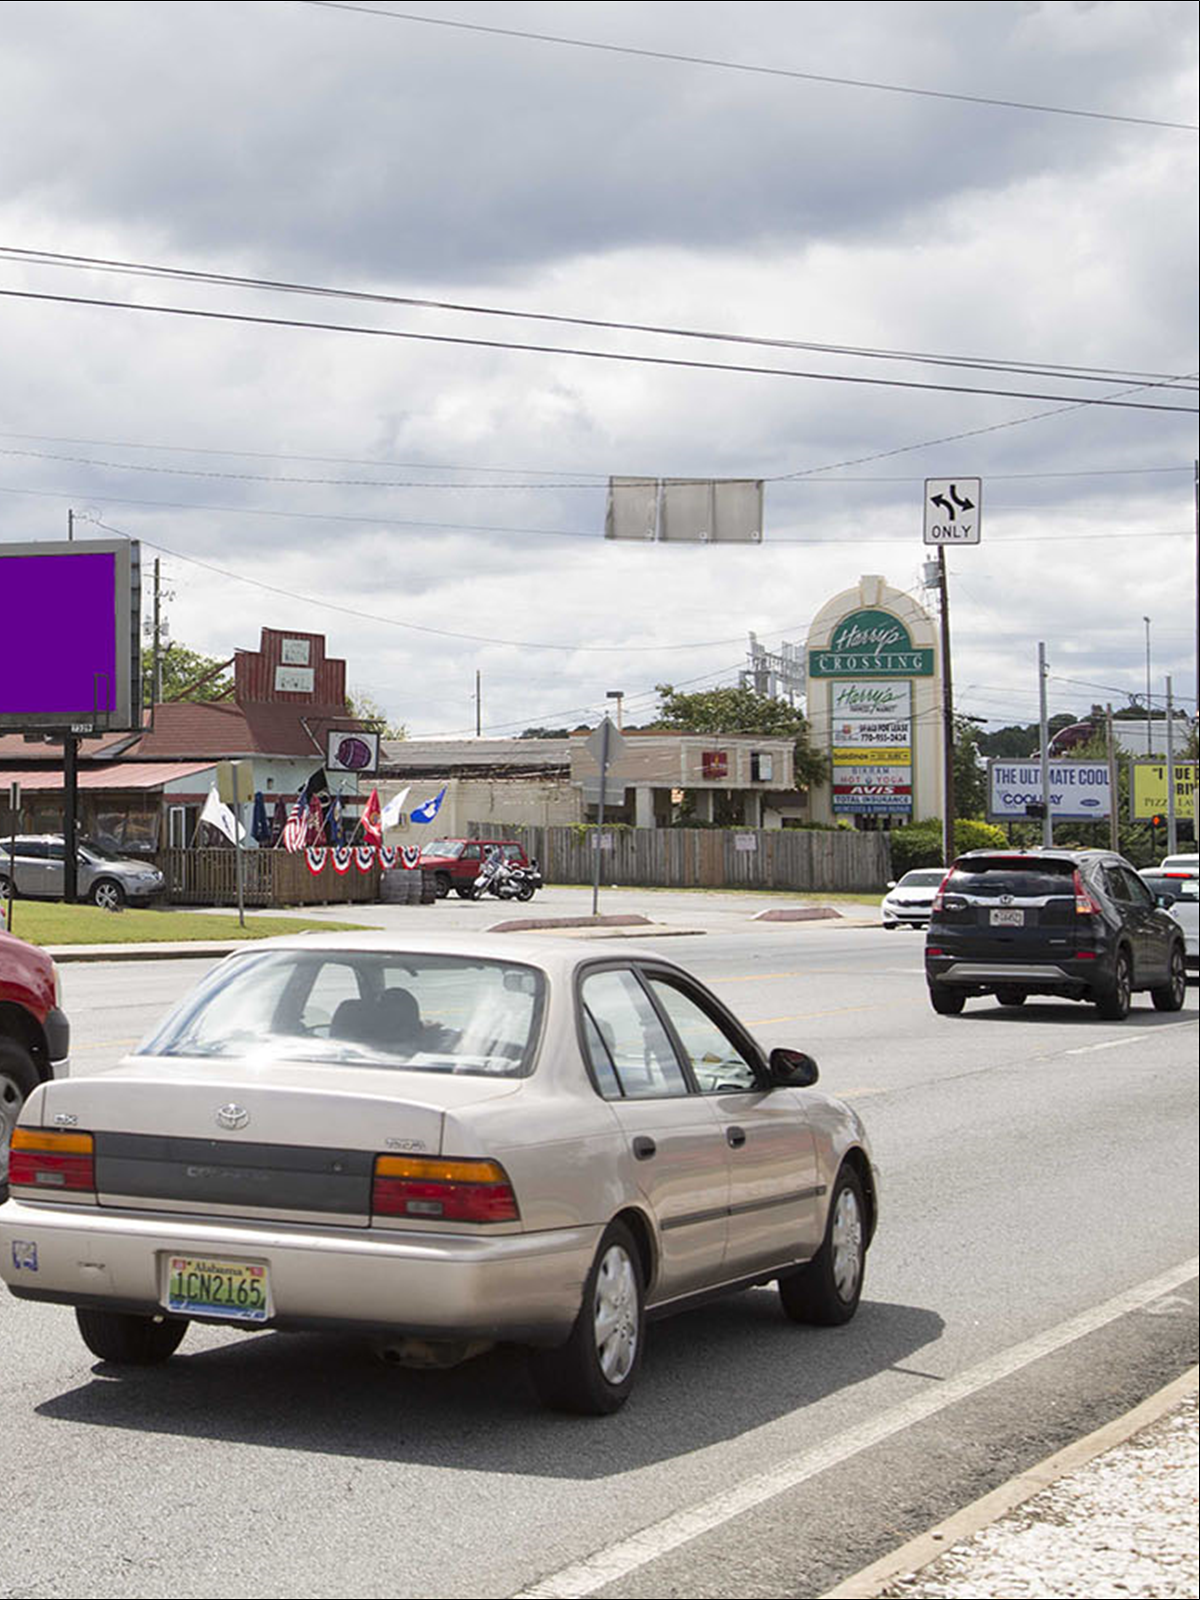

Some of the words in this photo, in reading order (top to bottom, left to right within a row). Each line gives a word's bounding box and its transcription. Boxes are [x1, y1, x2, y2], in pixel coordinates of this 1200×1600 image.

[932, 525, 971, 538] ONLY
[835, 624, 906, 656] Harry's
[819, 655, 923, 670] CROSSING
[836, 685, 907, 715] Harry's
[995, 768, 1017, 784] THE
[1019, 768, 1076, 785] ULTATE
[1078, 769, 1110, 785] COOL
[850, 786, 895, 794] AVIS
[1003, 794, 1063, 805] COOLAY
[194, 1262, 243, 1276] Alabama
[174, 1272, 261, 1307] 1CN2165
